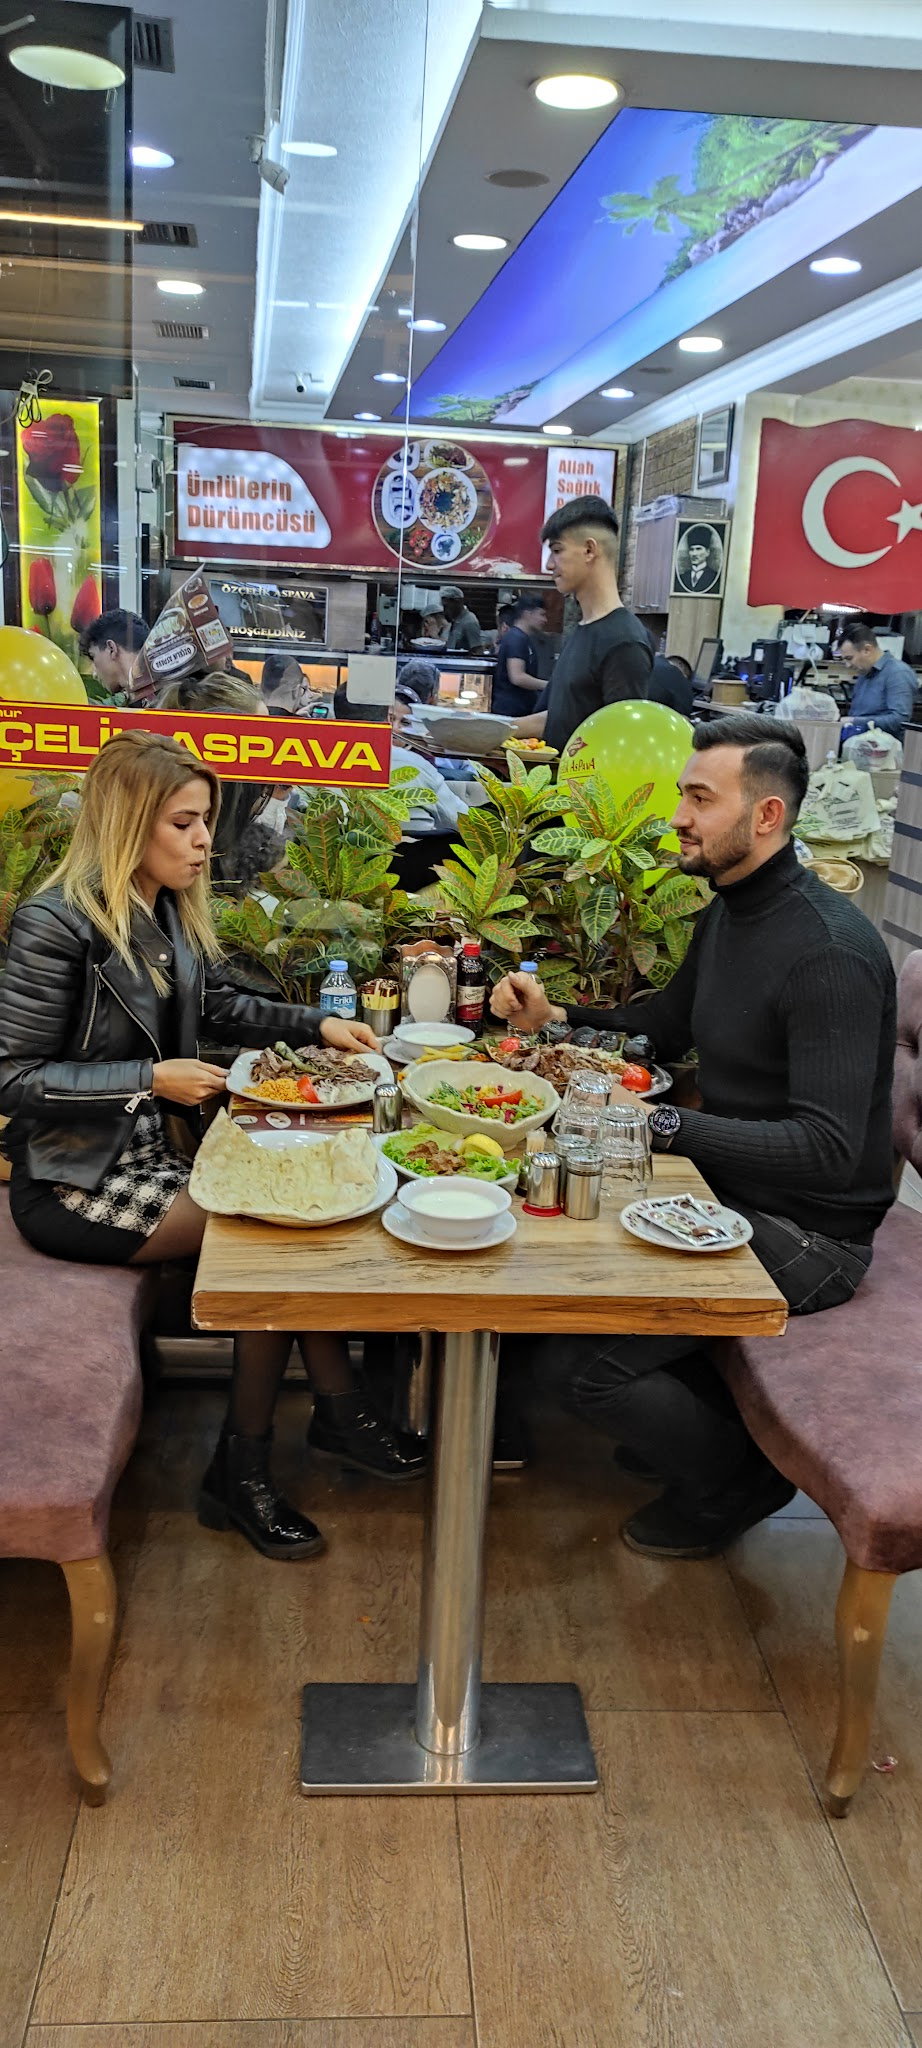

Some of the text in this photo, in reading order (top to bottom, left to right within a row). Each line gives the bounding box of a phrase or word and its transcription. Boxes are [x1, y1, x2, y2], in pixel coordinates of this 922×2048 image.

[558, 459, 594, 475] Allah
[187, 470, 293, 502] Ünlülerin
[557, 478, 601, 496] Sağlık
[187, 504, 316, 533] Dürümcüsü
[274, 589, 316, 600] ASPAVA
[229, 626, 306, 639] HOŞGELDİNİZ
[0, 717, 151, 762] ÇELİ
